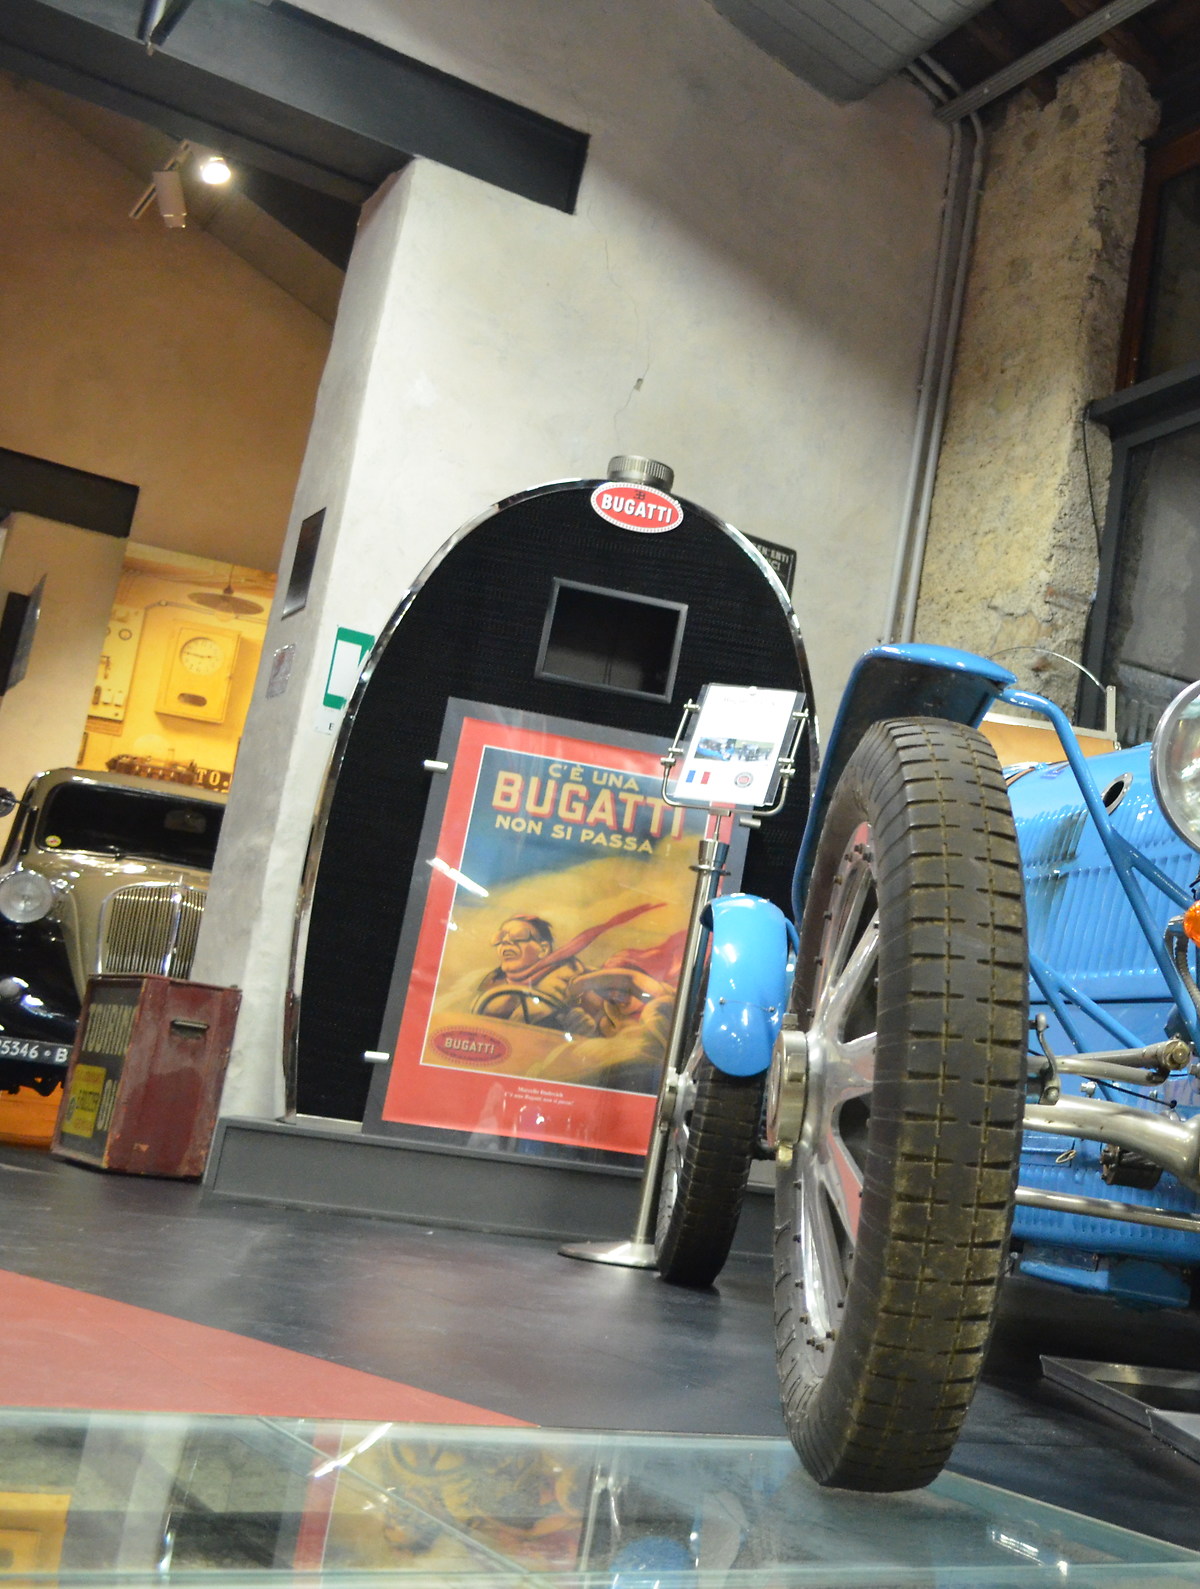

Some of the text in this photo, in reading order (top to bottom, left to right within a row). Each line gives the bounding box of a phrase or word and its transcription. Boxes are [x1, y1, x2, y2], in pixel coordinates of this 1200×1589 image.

[601, 493, 673, 524] BUGATTI
[548, 762, 640, 791] C'È UNA
[491, 769, 686, 841] BUGATTI
[495, 814, 543, 835] NON
[551, 824, 573, 840] SI
[580, 828, 654, 854] PASSA
[0, 1040, 39, 1059] 5346
[444, 1037, 496, 1054] BUGATTI
